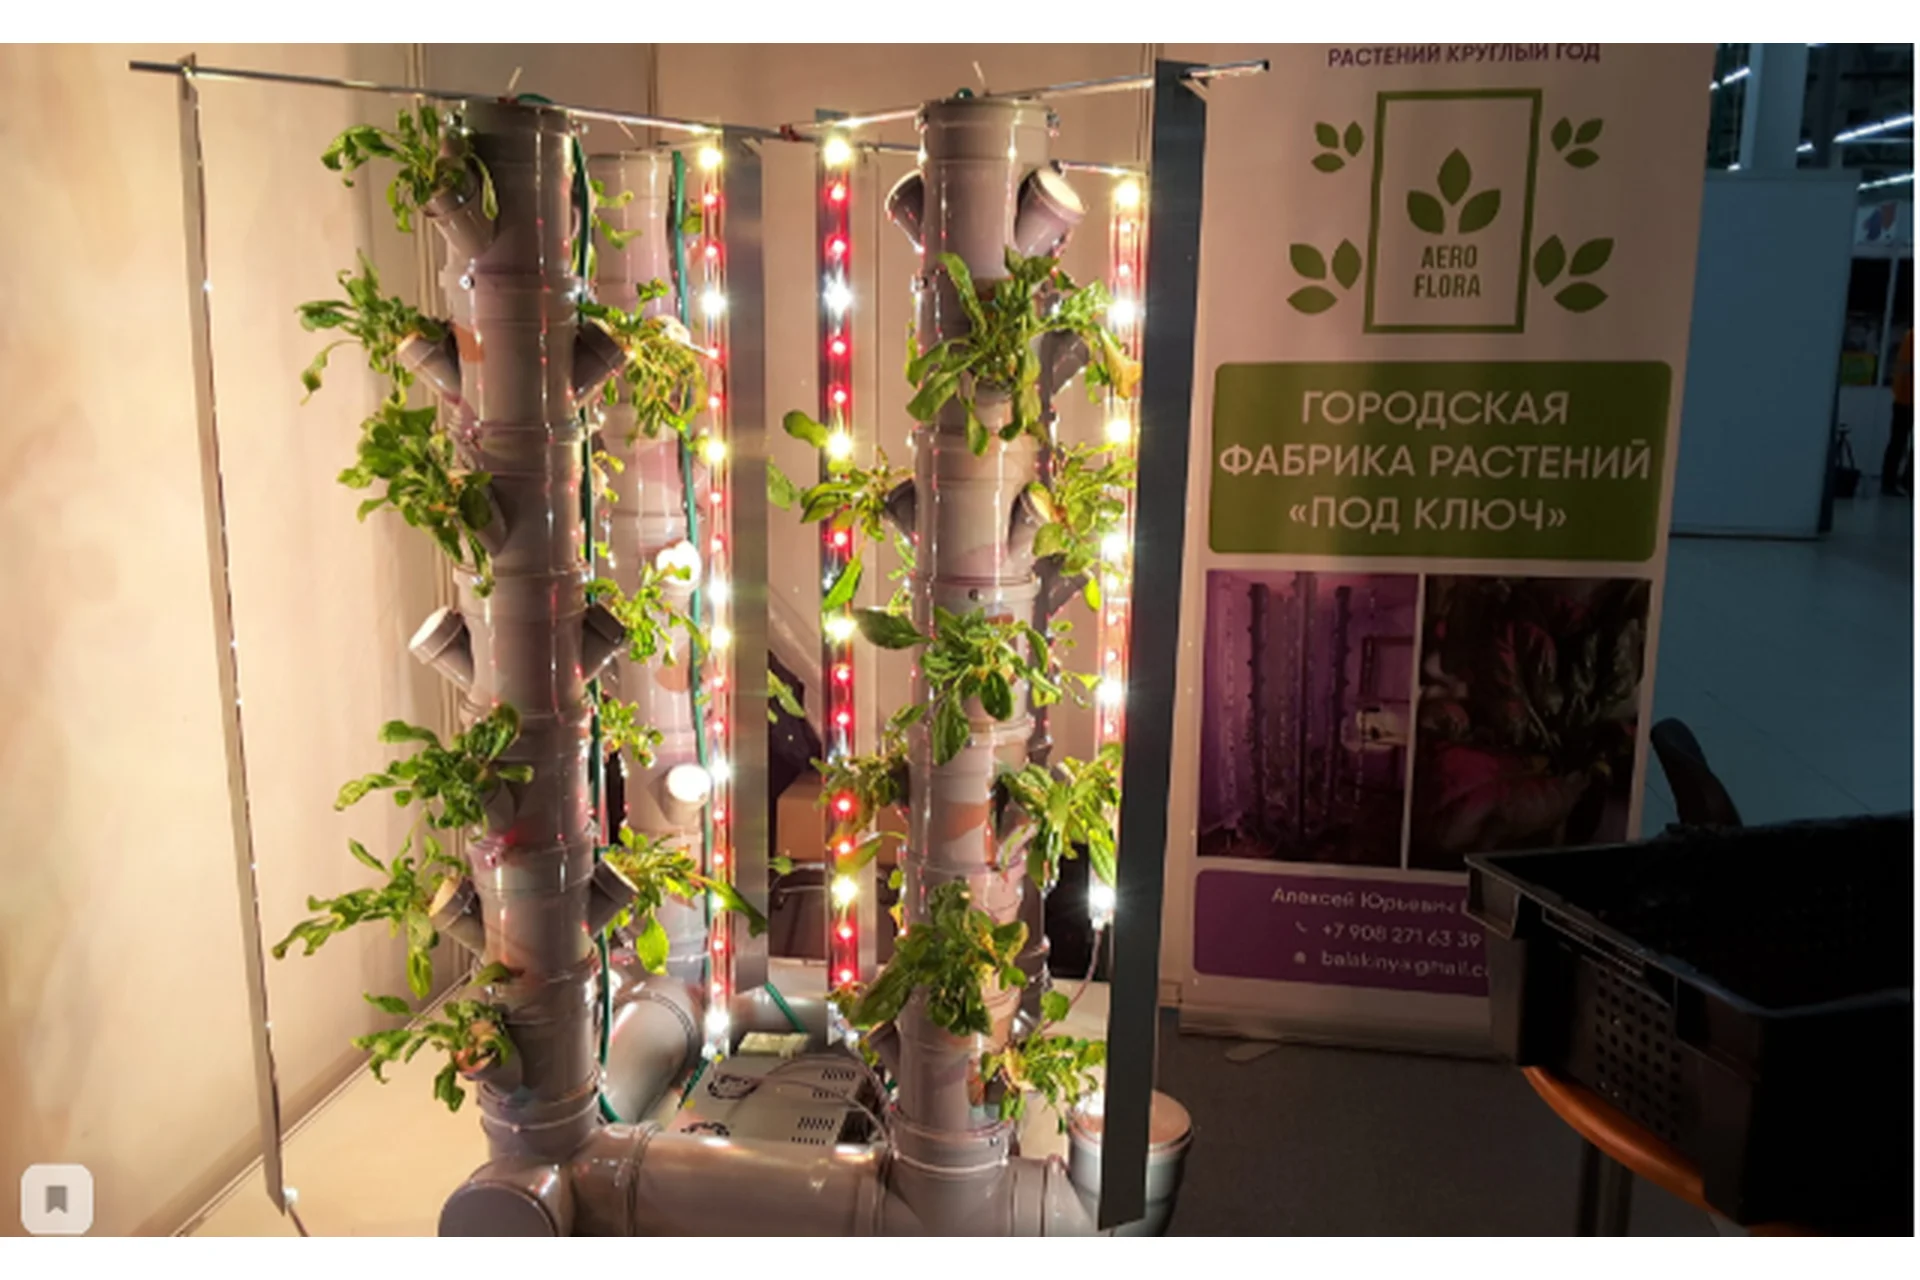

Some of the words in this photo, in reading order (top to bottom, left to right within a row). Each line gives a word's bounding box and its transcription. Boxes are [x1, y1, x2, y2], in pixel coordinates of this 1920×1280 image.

[1327, 44, 1441, 67] РАСТЕНИЙ
[1556, 44, 1601, 63] ГОД
[1420, 245, 1478, 269] AERO
[1413, 274, 1482, 298] FLORA
[1301, 391, 1570, 430] ГОРОДСКАЯ
[1219, 443, 1416, 478] ФАБРИКА
[1429, 440, 1652, 480] РАСТЕНИЙ
[1289, 496, 1400, 534] «ПОД
[1415, 497, 1568, 531] КЛЮЧ»
[1271, 886, 1355, 908] Алексей
[1360, 891, 1456, 914] Юрьевич
[1322, 922, 1344, 939] +7
[1349, 924, 1388, 942] 908
[1391, 927, 1422, 944] 271
[1427, 930, 1452, 947] 63
[1457, 932, 1482, 948] 39
